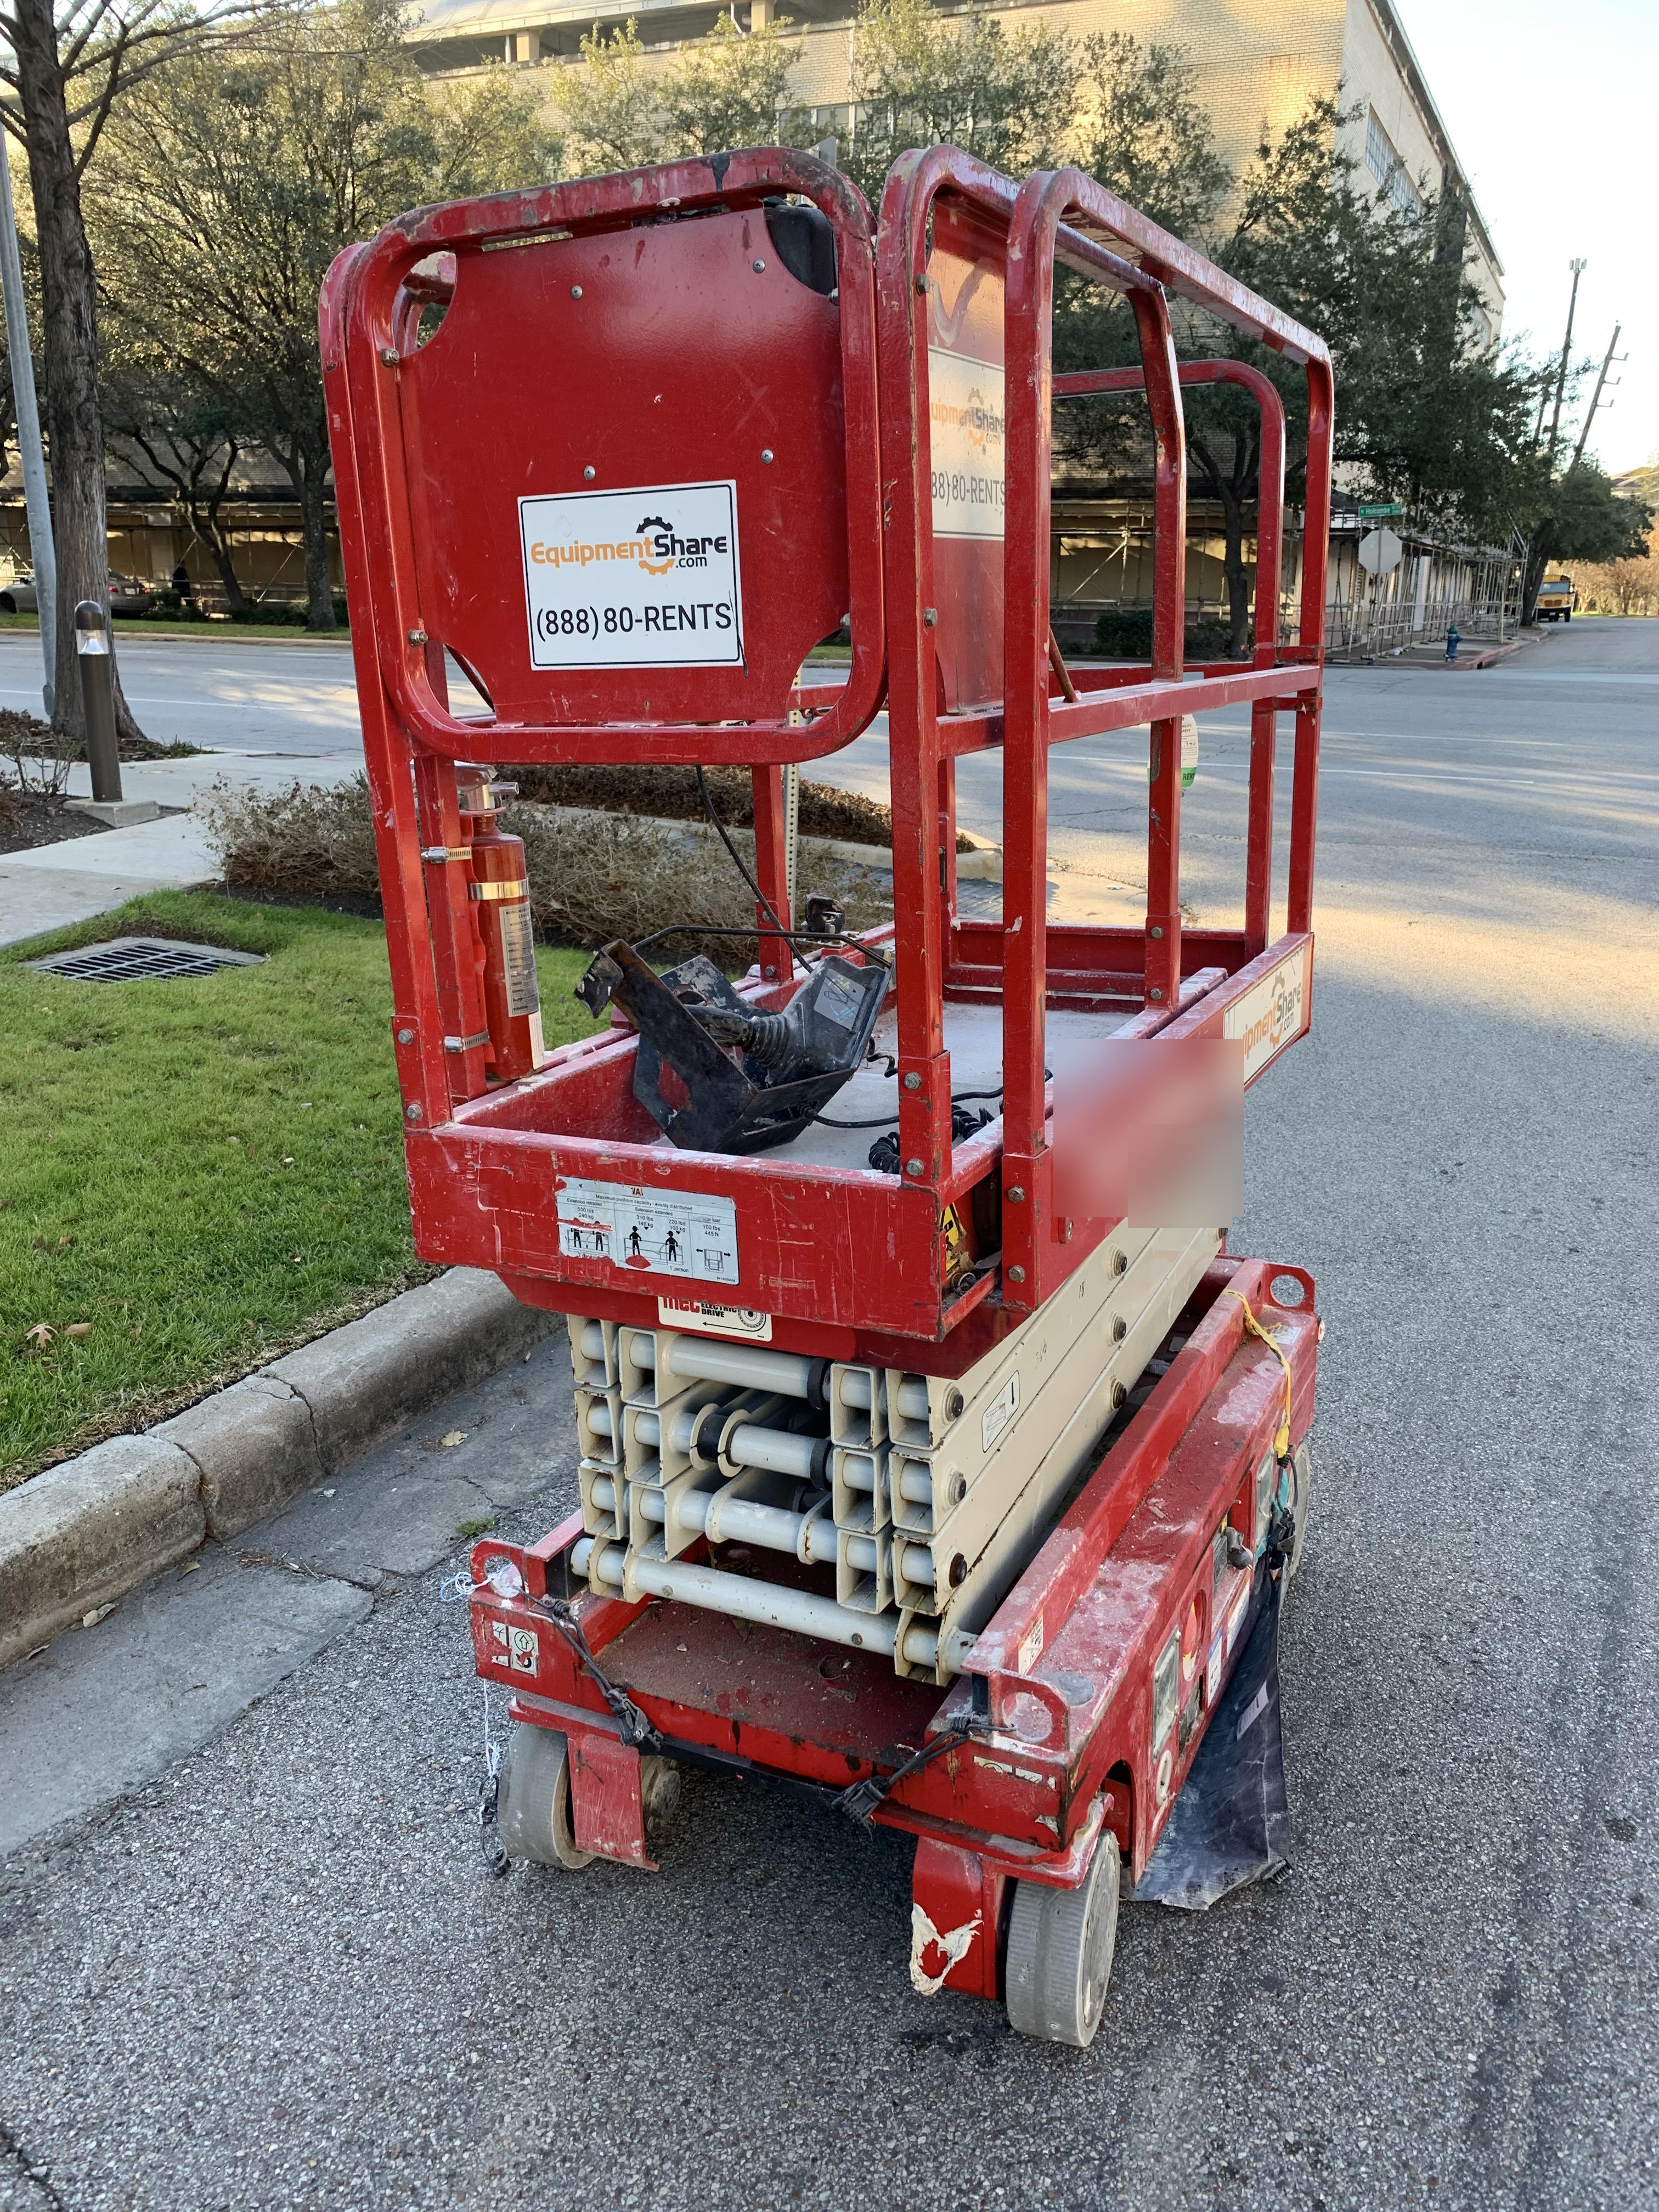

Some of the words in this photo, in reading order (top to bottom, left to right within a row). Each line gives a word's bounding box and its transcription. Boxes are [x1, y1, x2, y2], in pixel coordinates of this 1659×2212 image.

[531, 534, 727, 568] EquipmentShare
[675, 556, 708, 568] .com
[701, 1308, 725, 1318] DRIVE
